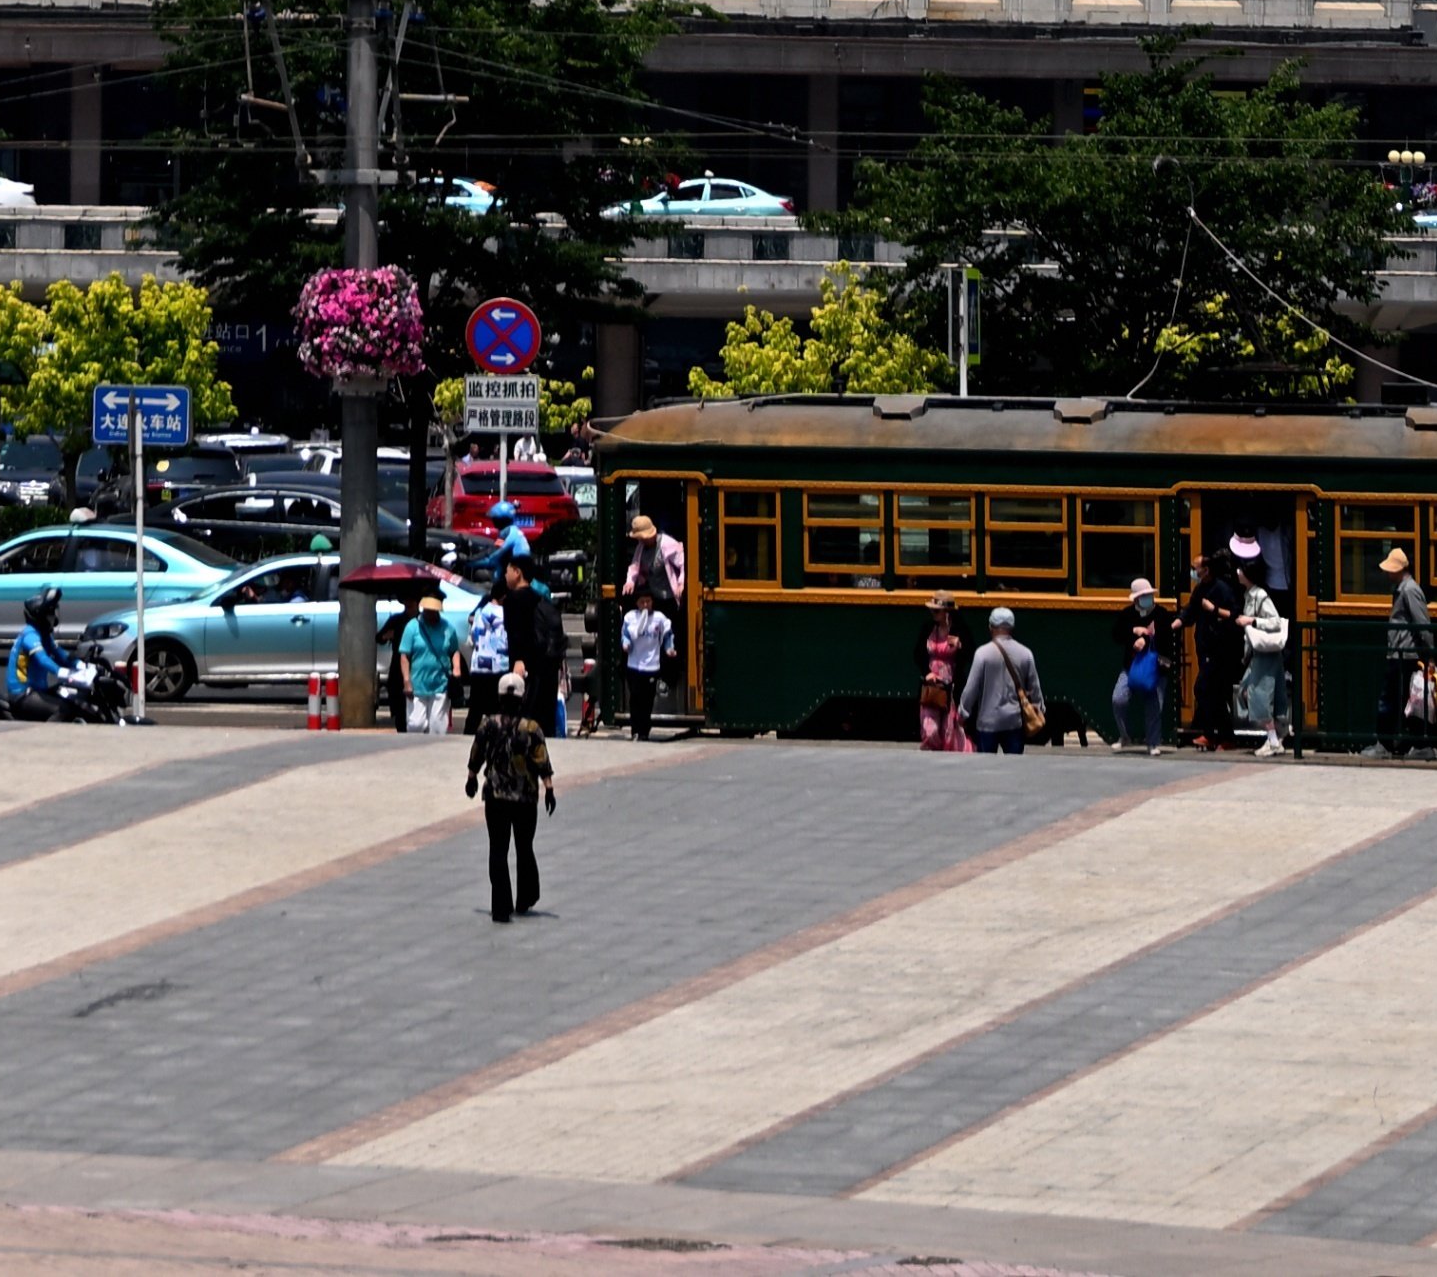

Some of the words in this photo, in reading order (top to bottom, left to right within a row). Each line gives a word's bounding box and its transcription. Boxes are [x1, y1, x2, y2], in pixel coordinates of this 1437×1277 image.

[468, 380, 536, 399] 监控抓拍
[467, 409, 535, 428] 严格管理路段
